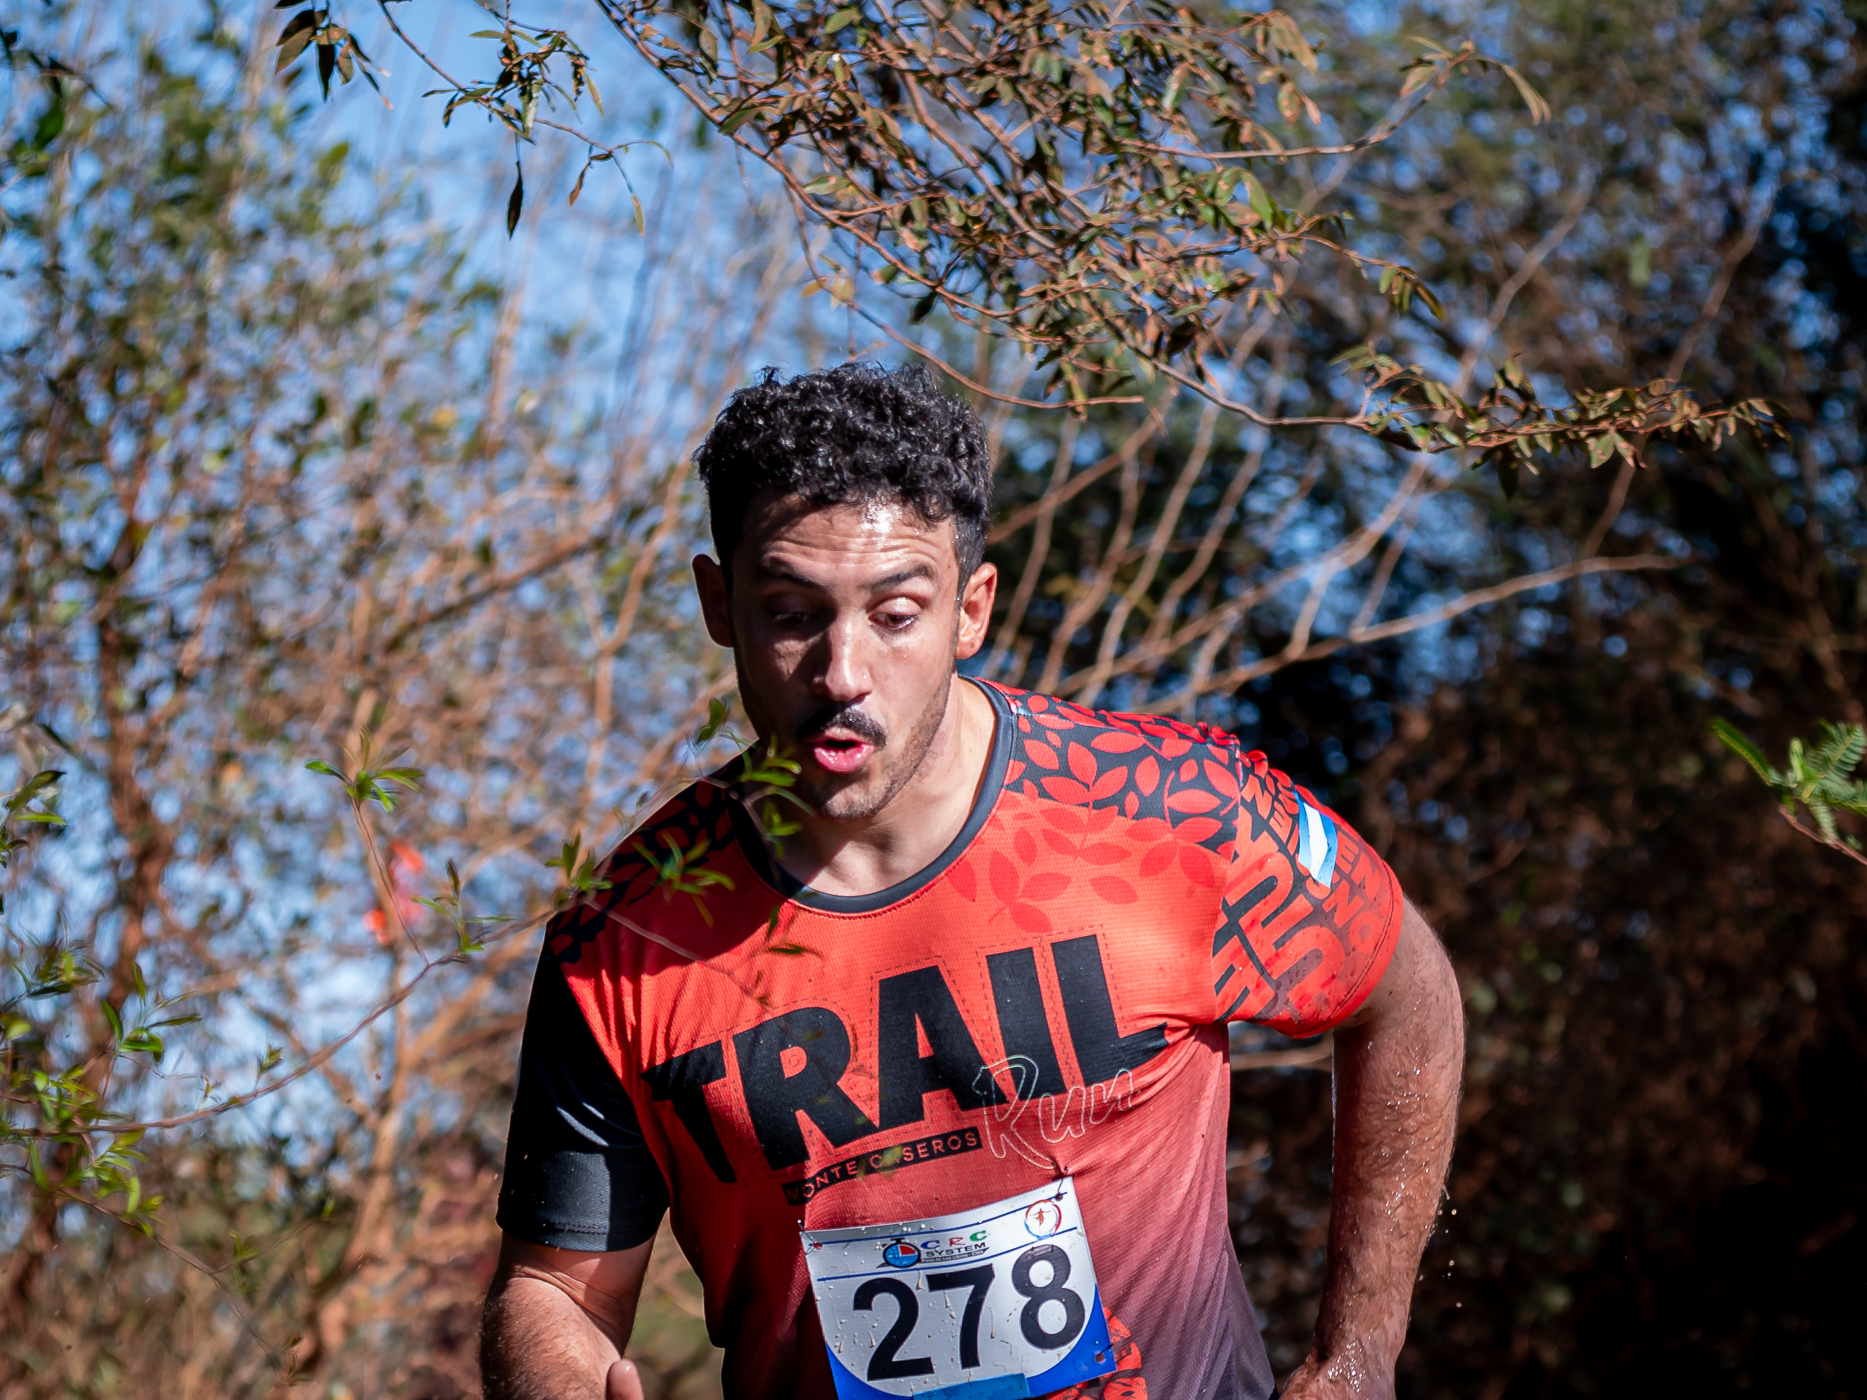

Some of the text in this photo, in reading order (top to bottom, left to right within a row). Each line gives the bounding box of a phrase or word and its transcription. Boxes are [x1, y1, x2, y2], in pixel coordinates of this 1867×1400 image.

[641, 933, 1168, 1184] TRAIL
[971, 1054, 1135, 1170] Run
[785, 1160, 858, 1200] MONTE
[925, 1242, 986, 1258] SYSTEM
[852, 1243, 1086, 1382] 278
